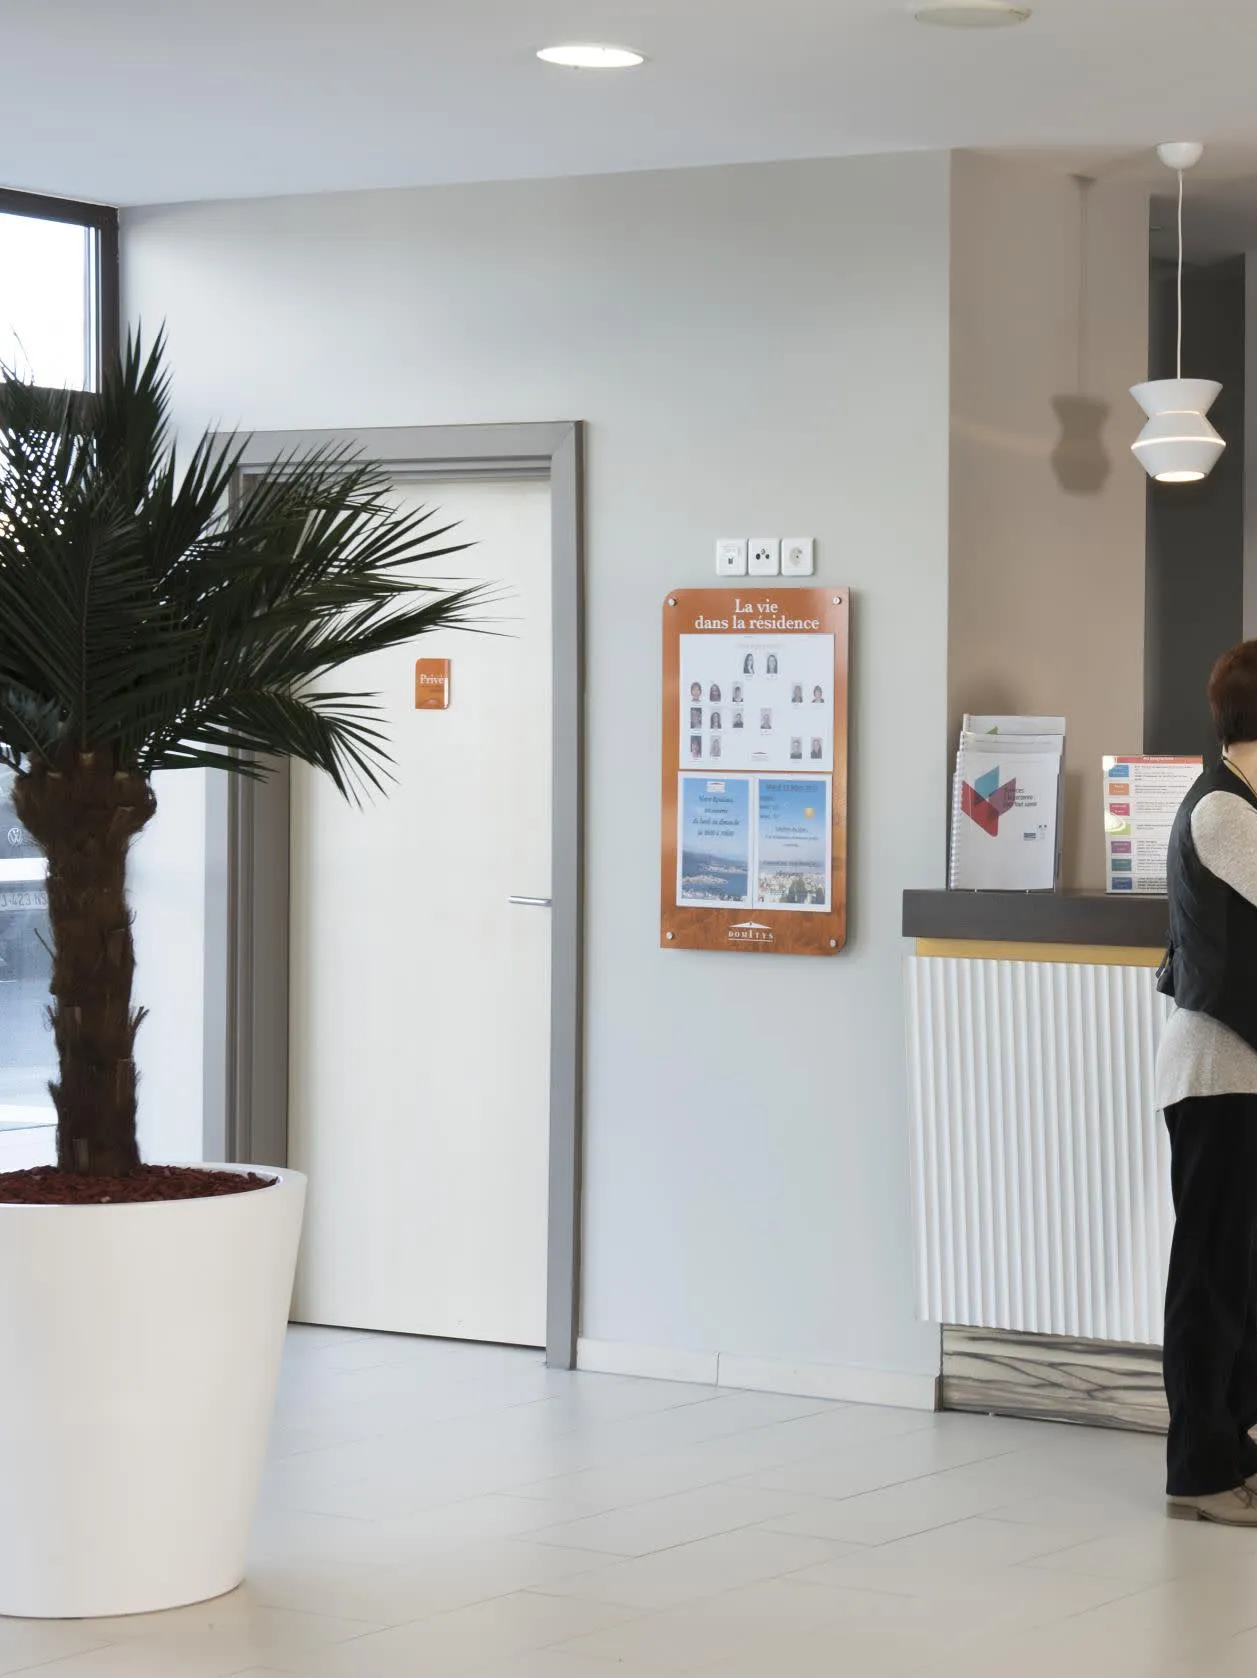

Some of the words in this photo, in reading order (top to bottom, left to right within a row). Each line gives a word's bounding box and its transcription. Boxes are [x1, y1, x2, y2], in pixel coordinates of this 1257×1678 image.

[734, 598, 754, 613] La
[757, 598, 779, 613] vie
[694, 615, 729, 629] dans
[732, 615, 746, 629] la
[749, 615, 820, 630] résidence
